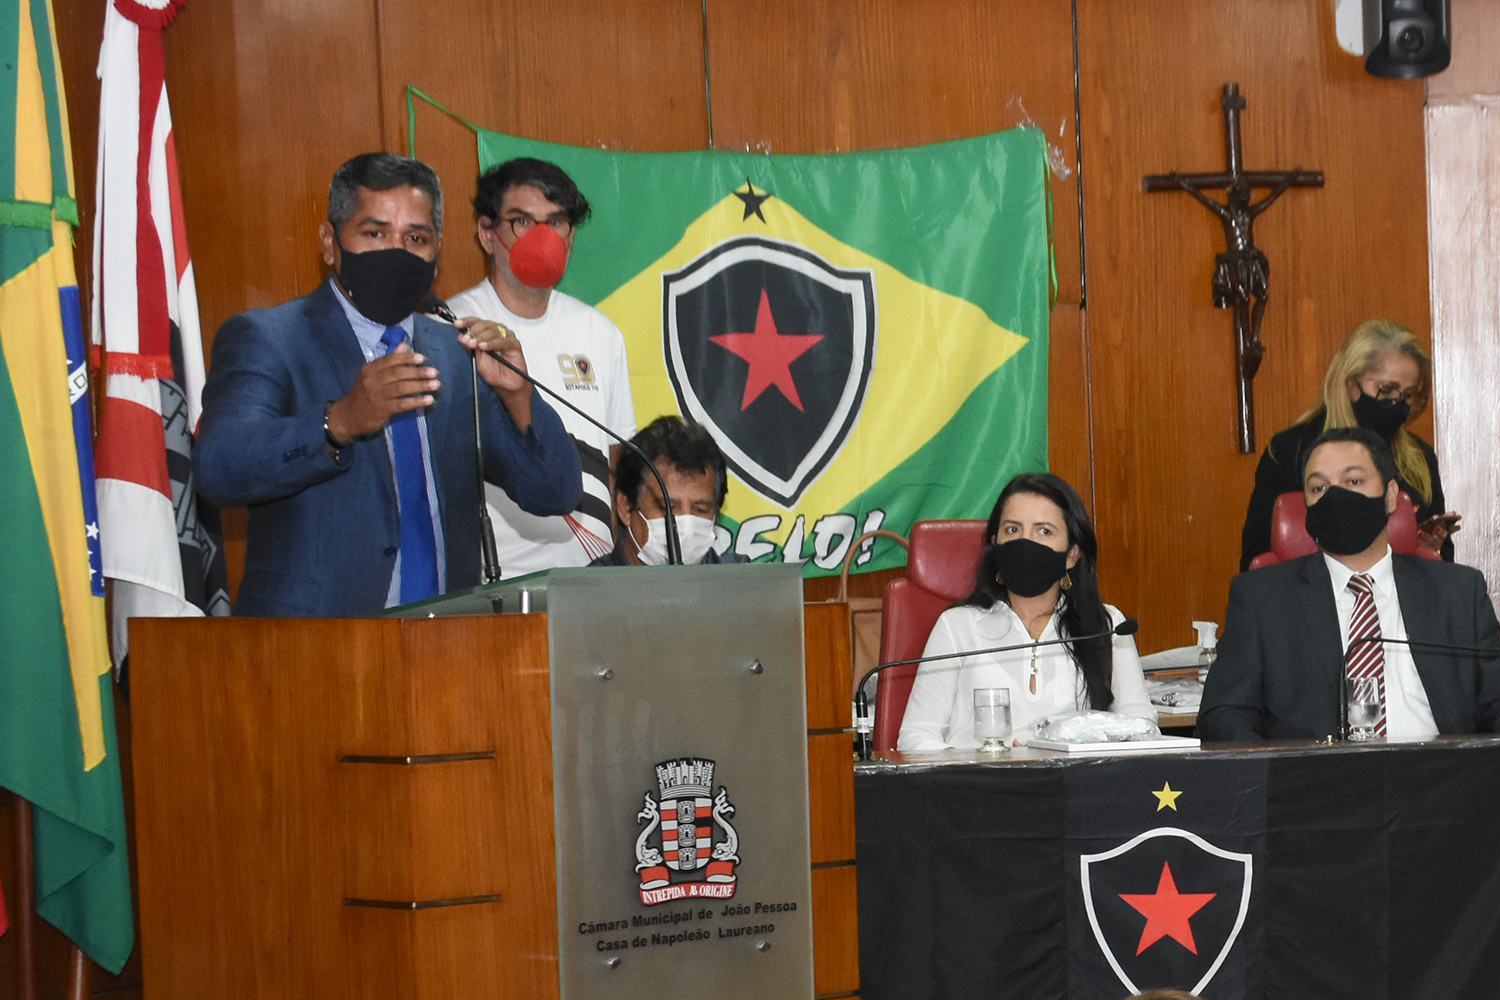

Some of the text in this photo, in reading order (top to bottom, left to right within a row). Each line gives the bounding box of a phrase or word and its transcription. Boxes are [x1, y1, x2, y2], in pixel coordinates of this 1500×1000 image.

[642, 885, 686, 904] INTREPIDA
[699, 884, 734, 897] ORIGINE
[632, 909, 693, 927] Municipal
[698, 908, 713, 920] de
[721, 903, 751, 917] João
[754, 902, 797, 914] Pessoa
[596, 924, 775, 952] Casa de Napoleão Laureano
